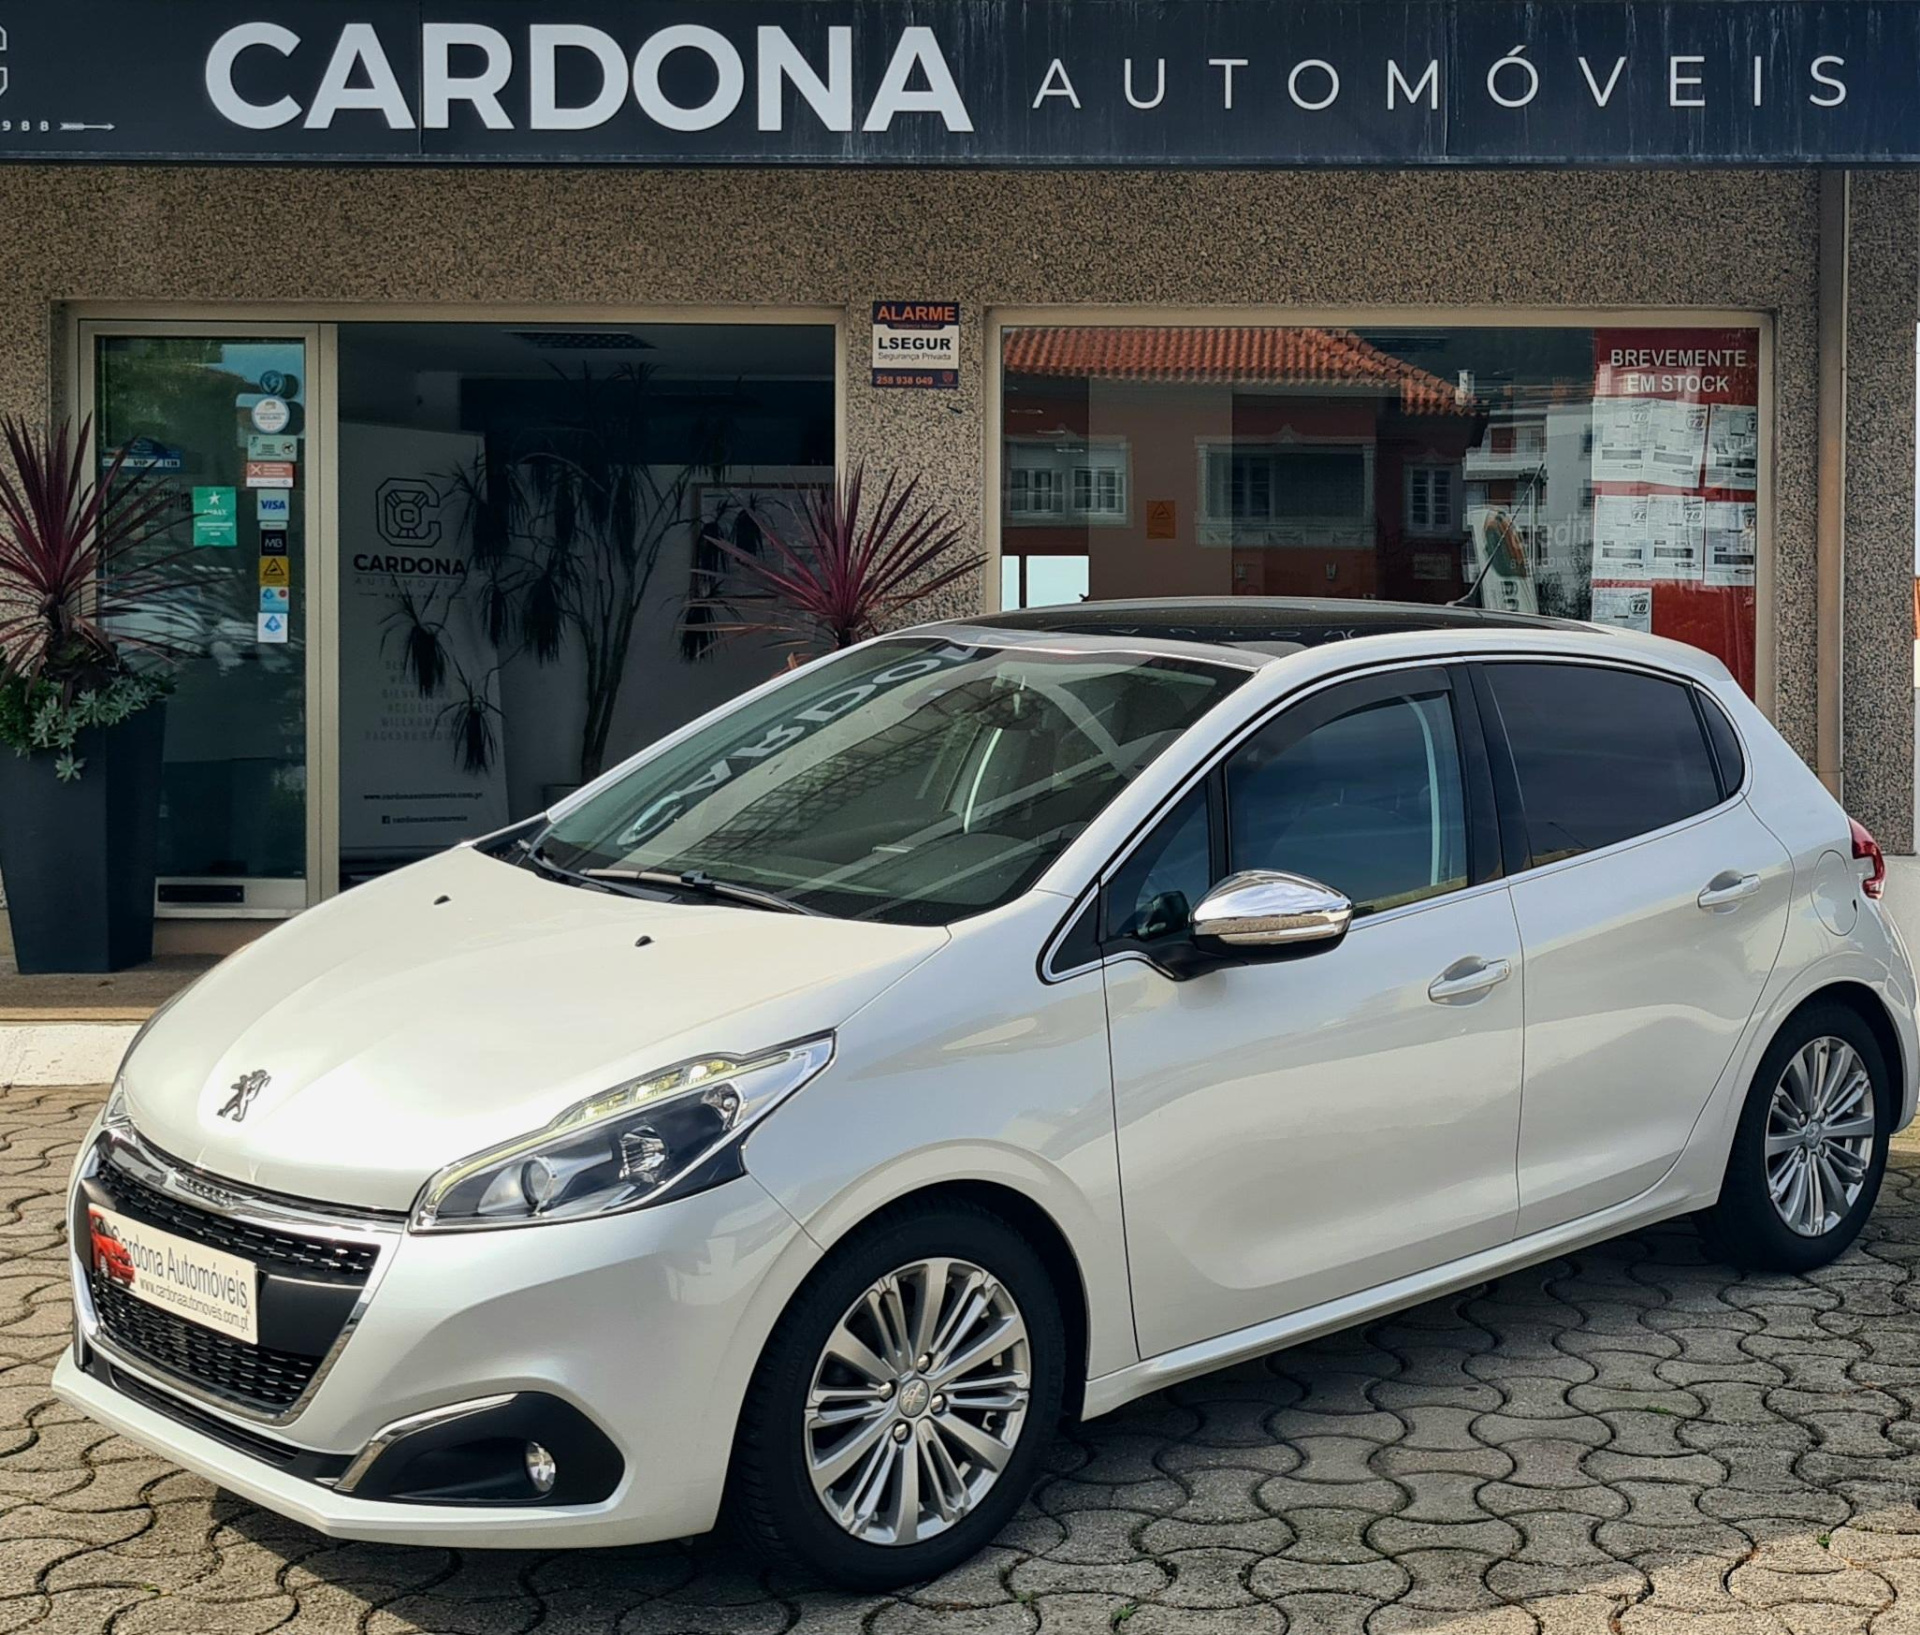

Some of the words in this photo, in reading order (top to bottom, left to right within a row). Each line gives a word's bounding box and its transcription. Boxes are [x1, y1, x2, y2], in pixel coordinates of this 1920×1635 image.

[204, 21, 975, 132] CARDONA
[1032, 45, 1849, 111] AUTOMÓVEIS
[877, 305, 956, 321] ALARME
[878, 337, 951, 350] LSEGUR
[878, 352, 920, 361] Segurança
[922, 352, 952, 360] Privada
[1610, 349, 1747, 368] BREVEMENTE
[1627, 375, 1656, 392] EM
[1661, 375, 1730, 393] STOCK
[260, 499, 286, 510] VISA
[264, 537, 284, 548] MB
[353, 554, 466, 576] CARDONA
[167, 1246, 248, 1310] Automóveis
